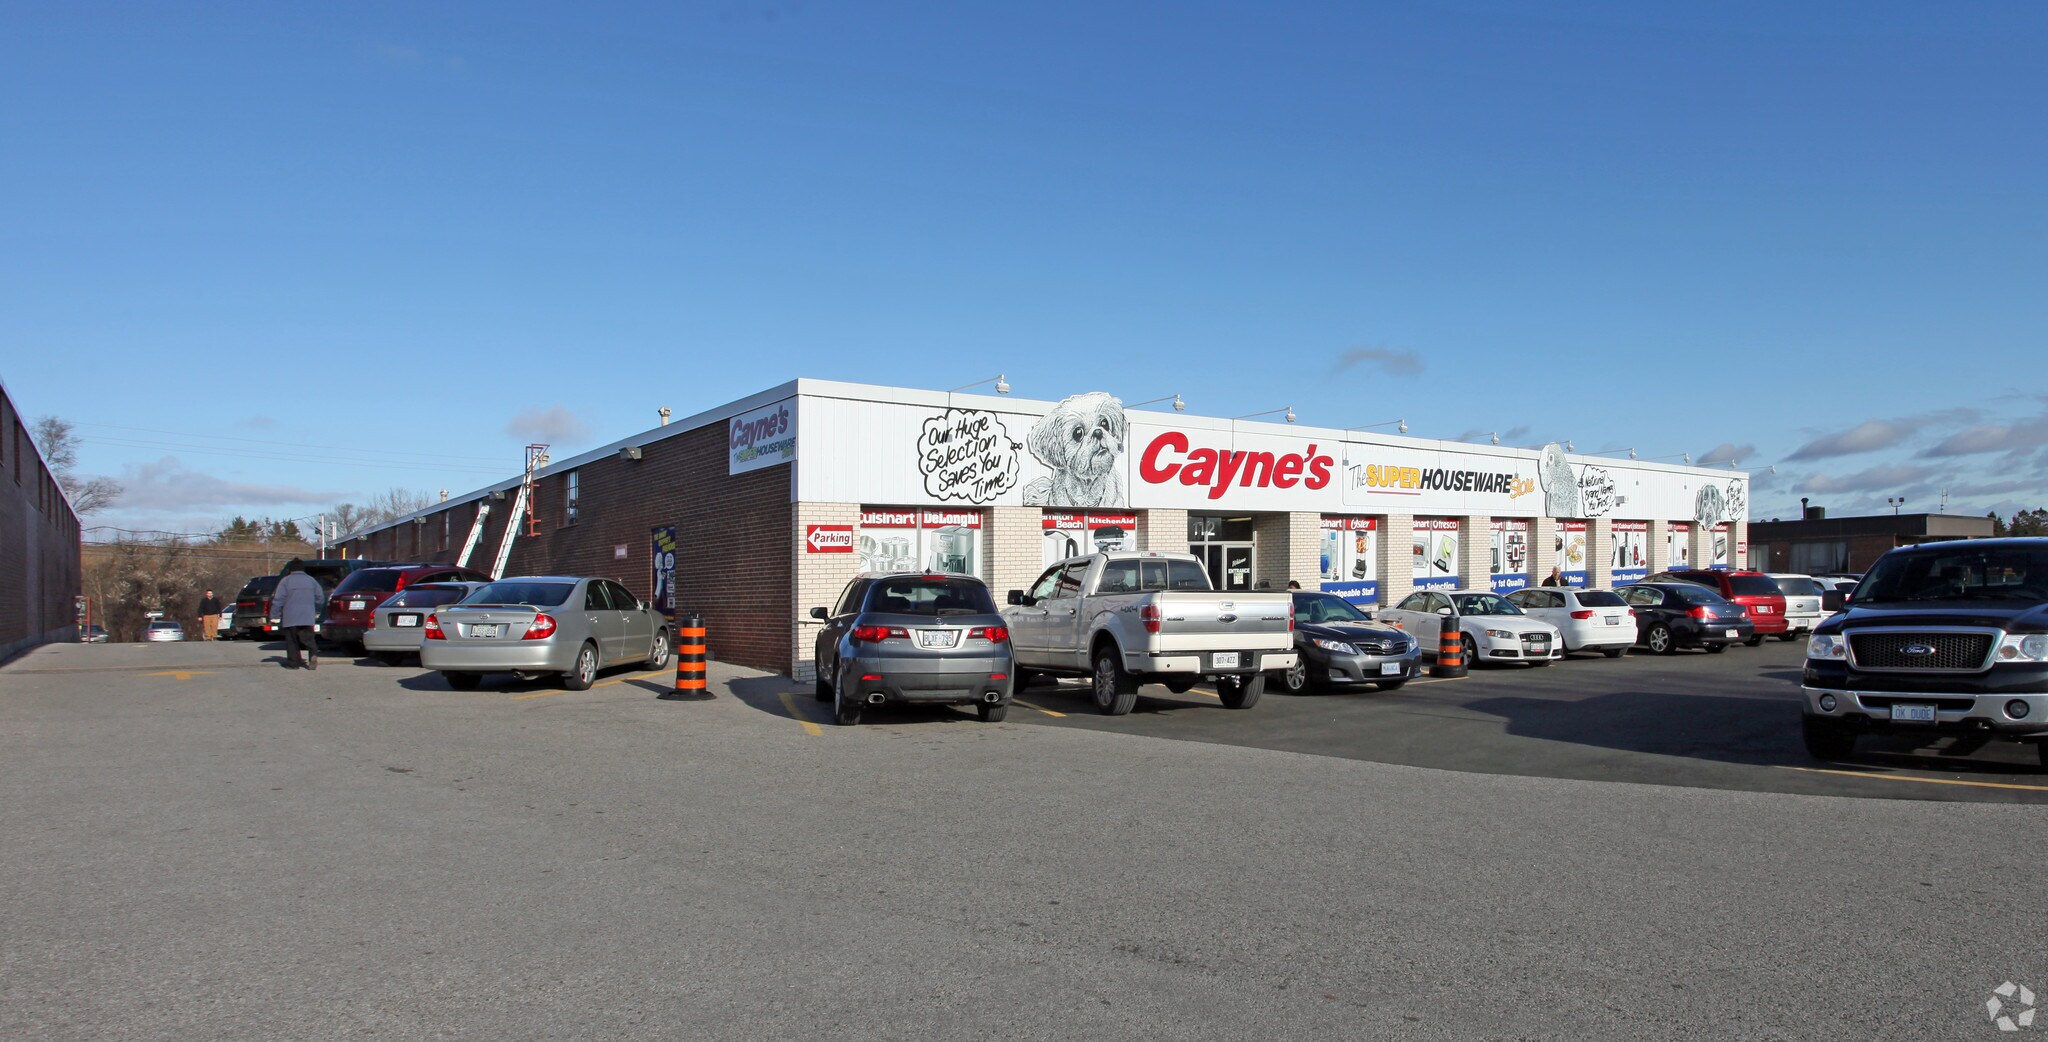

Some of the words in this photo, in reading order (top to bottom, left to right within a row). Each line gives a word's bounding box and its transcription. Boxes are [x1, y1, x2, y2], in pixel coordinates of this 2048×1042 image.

[731, 405, 788, 449] Cayne's
[929, 427, 953, 446] Our
[955, 416, 989, 440] Huge
[926, 434, 997, 473] Selection
[1139, 431, 1334, 499] Cayne's
[939, 462, 977, 492] Saves
[979, 452, 1001, 474] You
[1349, 464, 1367, 490] The
[1366, 464, 1421, 488] SUPER
[1420, 469, 1513, 494] HOUSEWARE
[923, 510, 979, 527] DeLonghi
[1056, 521, 1083, 529] Beach
[1351, 517, 1371, 530] Oster
[814, 533, 850, 545] Parking
[1506, 578, 1526, 588] Quality
[1568, 575, 1583, 583] Prices
[1362, 586, 1375, 596] Staff
[1426, 582, 1456, 591] Selection
[1895, 708, 1906, 718] OK
